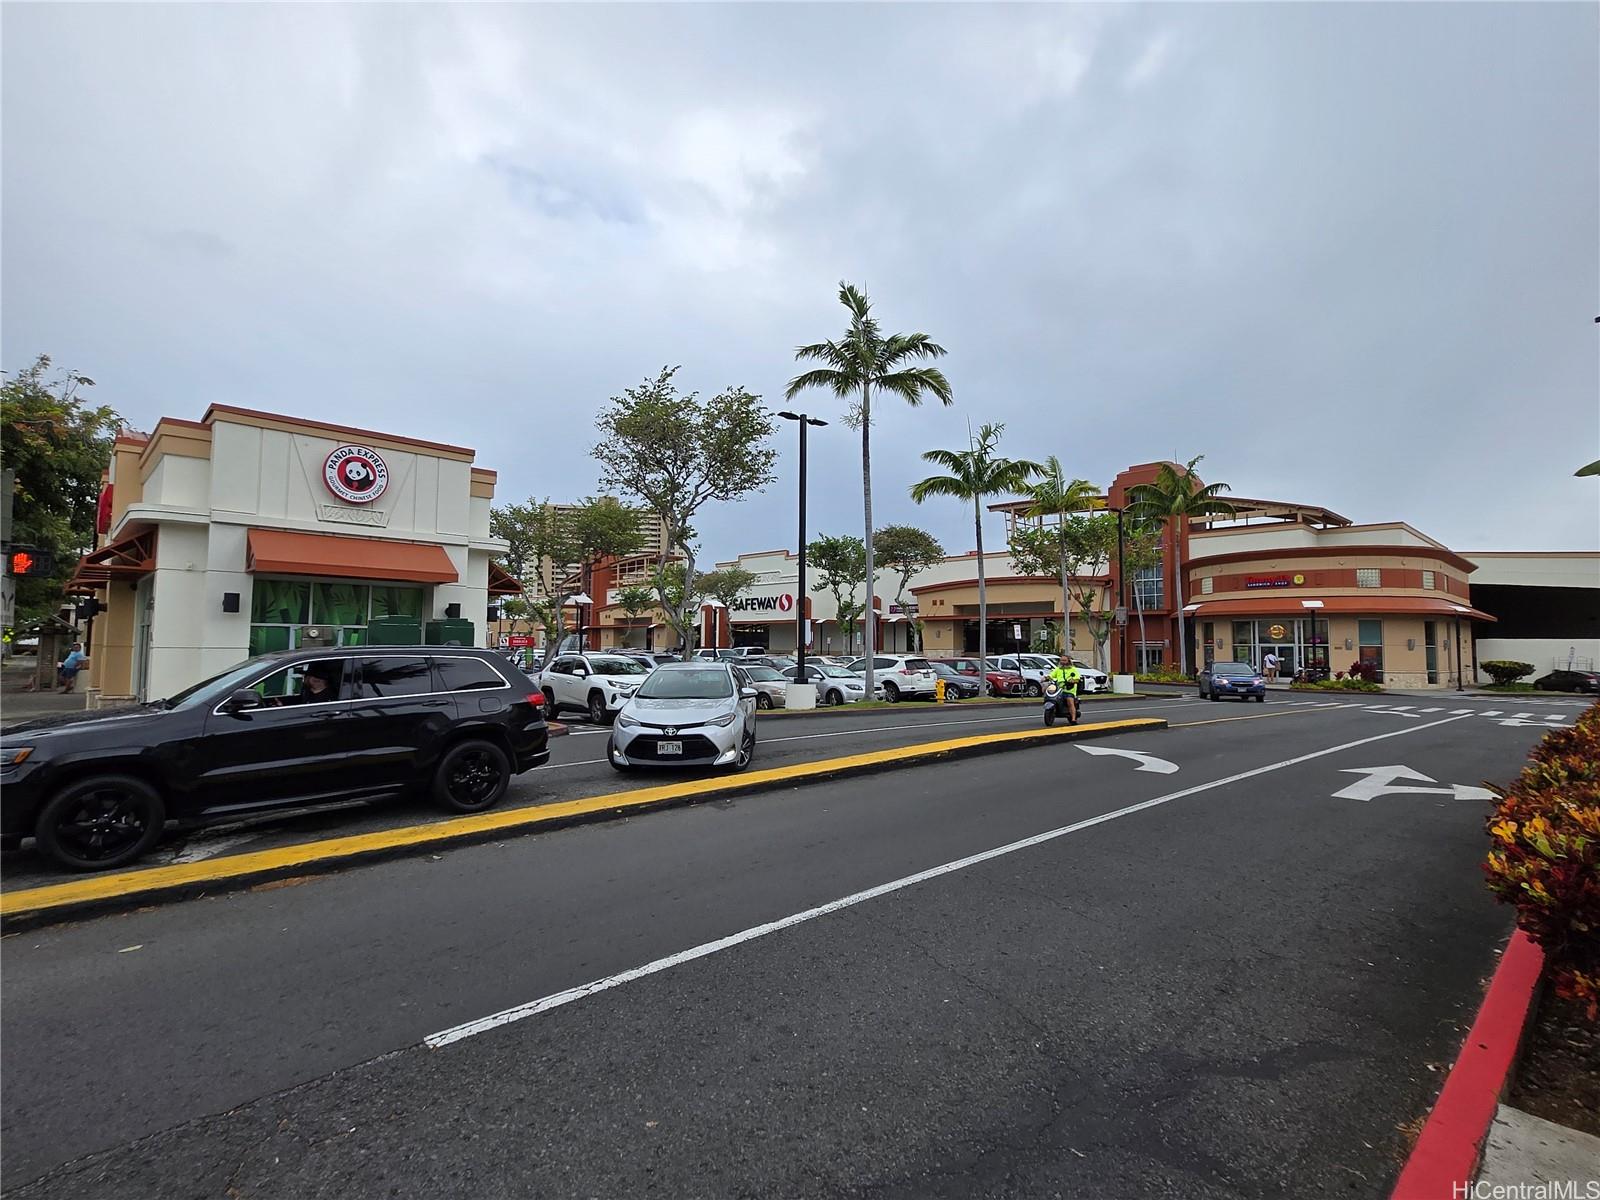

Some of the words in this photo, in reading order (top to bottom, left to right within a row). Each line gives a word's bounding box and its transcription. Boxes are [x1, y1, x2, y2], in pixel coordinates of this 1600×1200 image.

[328, 448, 354, 470] PANDA
[357, 448, 386, 479] EXPRESS
[328, 475, 349, 497] GOURMET
[372, 484, 384, 496] FOOD
[732, 596, 779, 611] SAFEWAY
